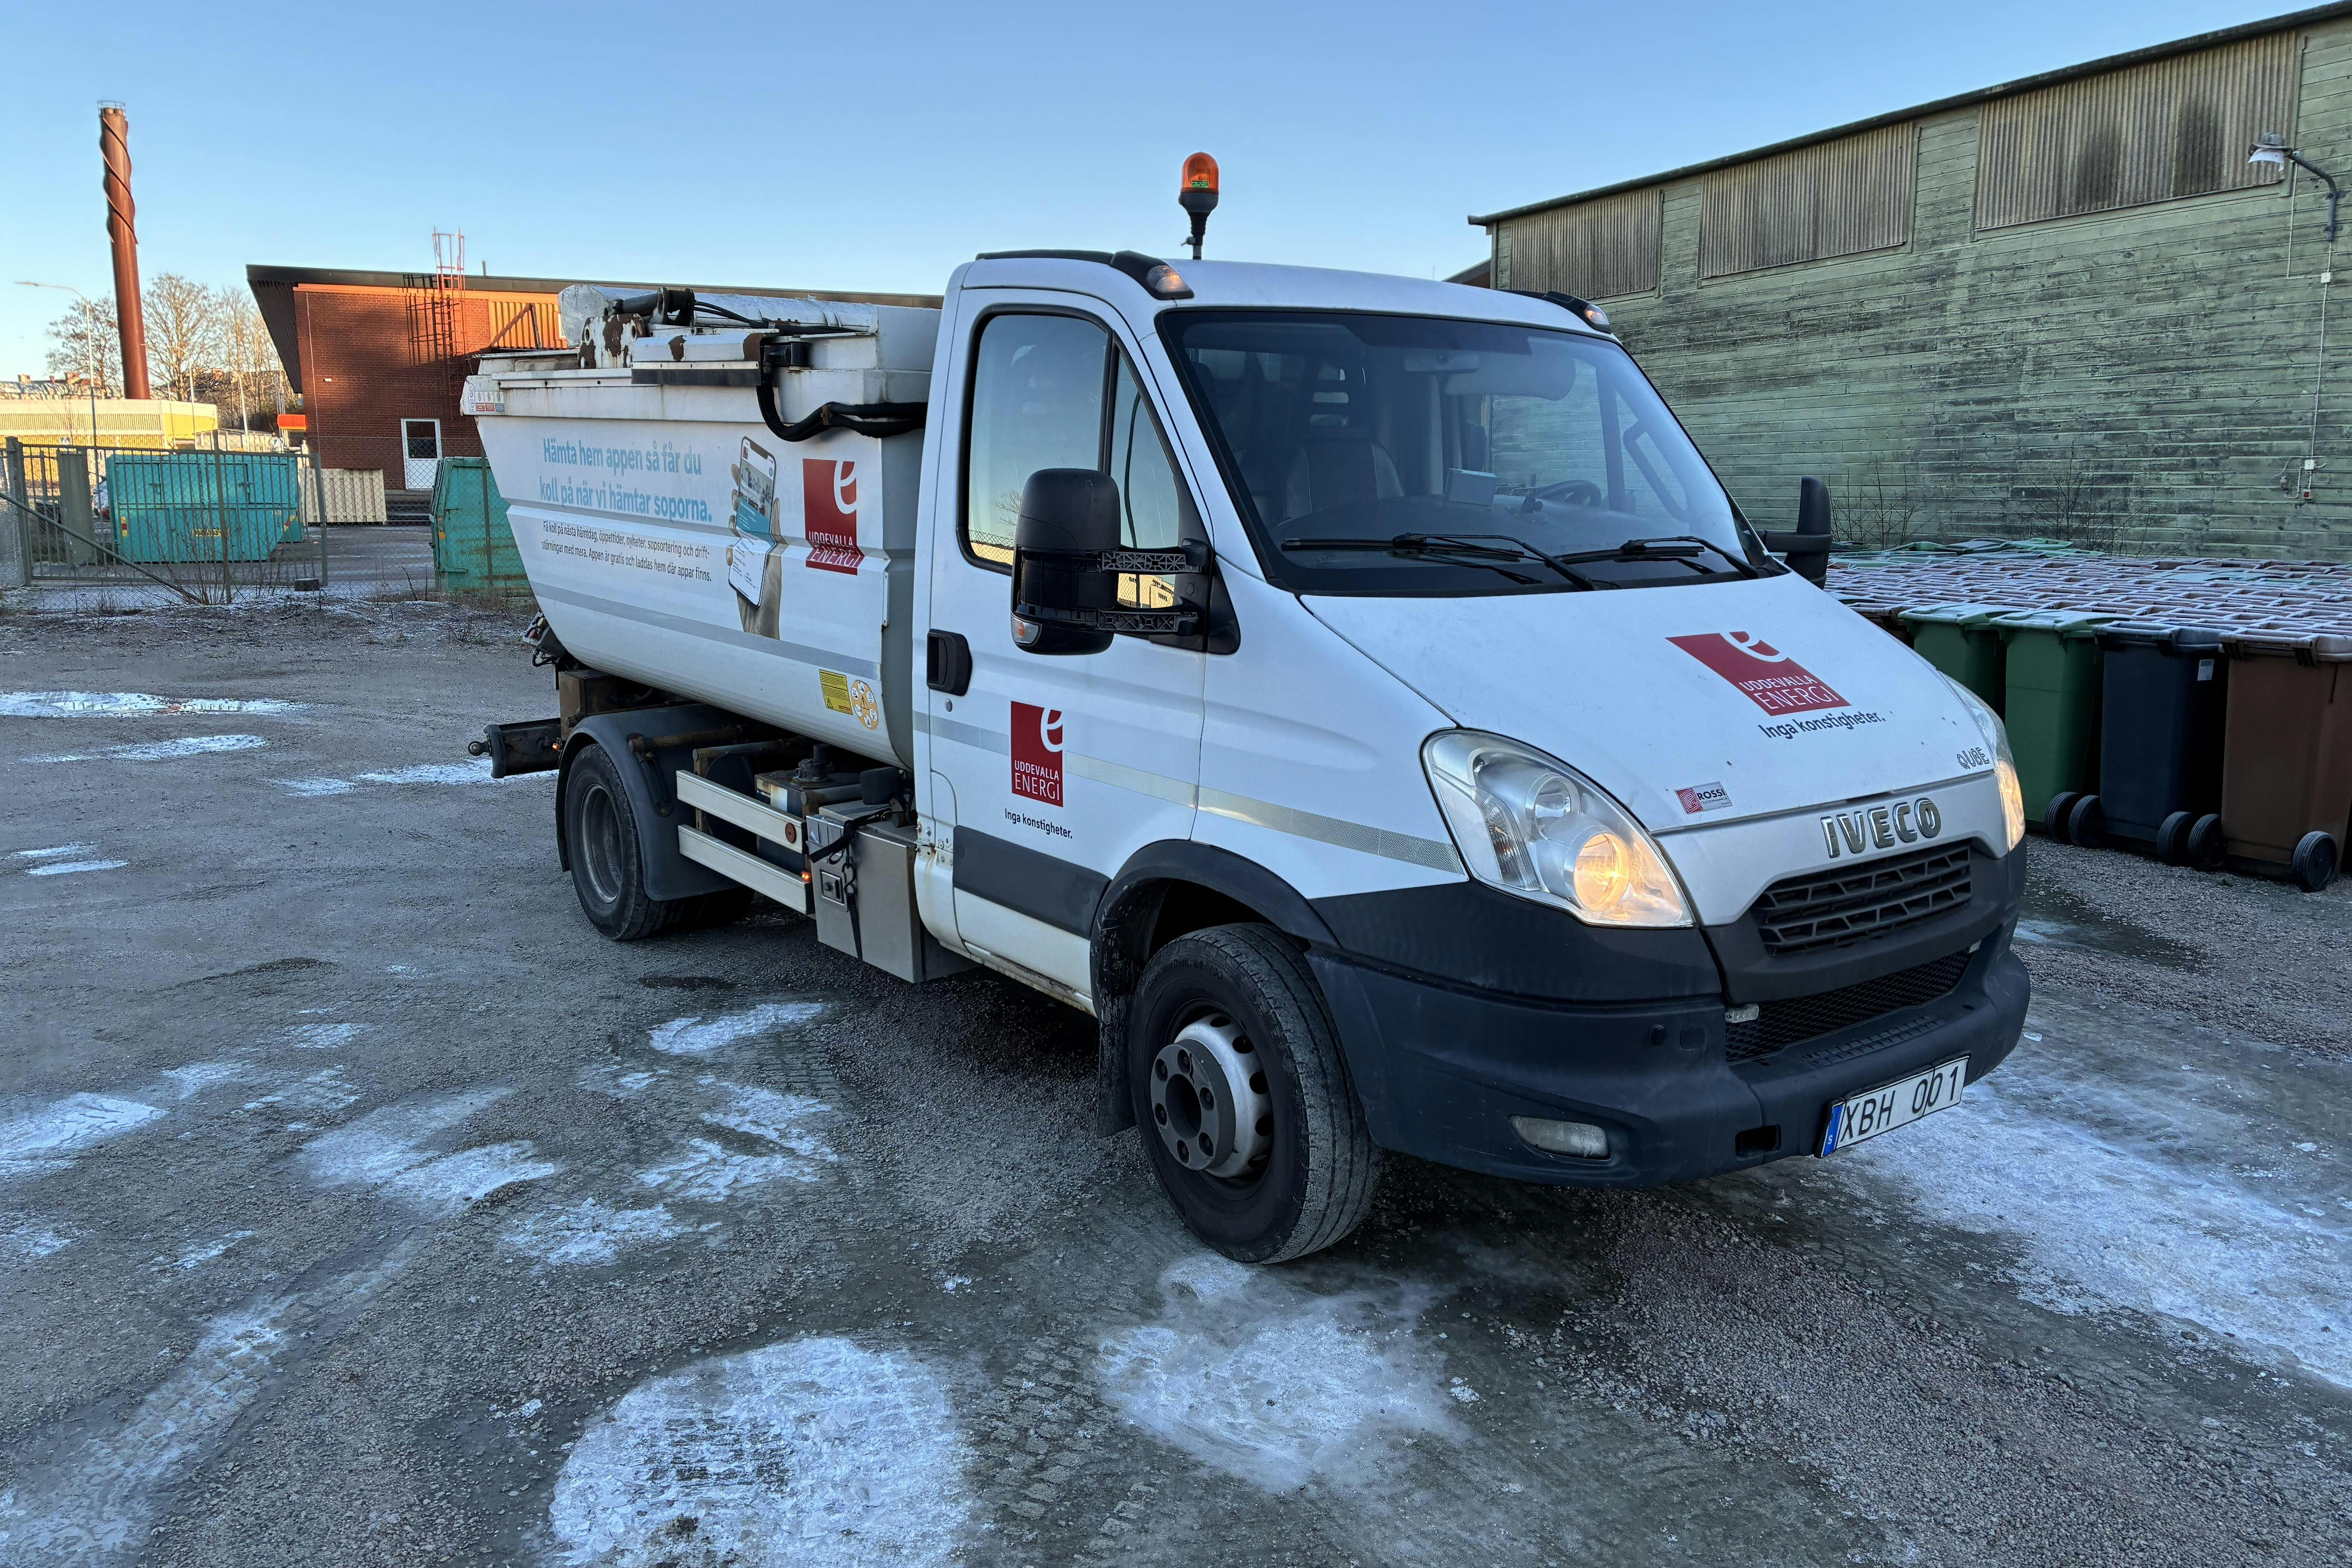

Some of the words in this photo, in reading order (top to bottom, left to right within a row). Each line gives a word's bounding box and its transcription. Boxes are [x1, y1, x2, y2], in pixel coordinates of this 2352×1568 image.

[543, 438, 576, 465] Hämta
[579, 440, 604, 467] hem
[606, 448, 643, 476] appen
[645, 440, 659, 471] så
[662, 441, 681, 473] får
[684, 445, 702, 475] du
[539, 476, 559, 502] koll
[560, 476, 574, 509] på
[576, 480, 593, 506] när
[595, 481, 607, 509] vi
[609, 483, 651, 514] hämtar
[654, 495, 712, 523] soporna.
[543, 520, 549, 532] Få
[557, 523, 564, 536] på
[564, 525, 576, 537] nästa
[577, 526, 598, 543] hämtdag,
[599, 530, 625, 546] öppettider,
[626, 535, 646, 549] nyheter,
[647, 540, 682, 558] sopsortering
[683, 544, 693, 557] och
[695, 545, 710, 559] drift-
[808, 530, 855, 548] UDDEVALLA
[541, 540, 563, 555] störningar
[564, 544, 574, 555] med
[574, 547, 588, 558] mera.
[588, 548, 604, 562] Appen
[604, 550, 610, 562] är
[611, 552, 625, 565] gratis
[625, 555, 635, 567] och
[635, 555, 653, 570] laddas
[654, 559, 666, 573] hem
[667, 562, 676, 574] där
[678, 566, 694, 581] appar
[695, 567, 712, 582] finns.
[810, 545, 861, 567] ENERGI
[1738, 675, 1818, 692] UDDEVALLA
[1753, 685, 1840, 710] ENERGI
[1757, 723, 1799, 740] Inga
[1794, 710, 1887, 732] konstigheter.
[1014, 760, 1059, 781] UDDEVALLA
[1957, 747, 1990, 770] QUBE
[1015, 772, 1060, 801] ENERGI
[1696, 788, 1726, 800] ROSSI
[1005, 808, 1021, 824] Inga
[1022, 813, 1073, 839] konstigheter.
[1820, 797, 1942, 859] IVECO
[1839, 1090, 1896, 1143] XBH
[1911, 1065, 1959, 1114] 001
[1827, 1134, 1833, 1146] S
